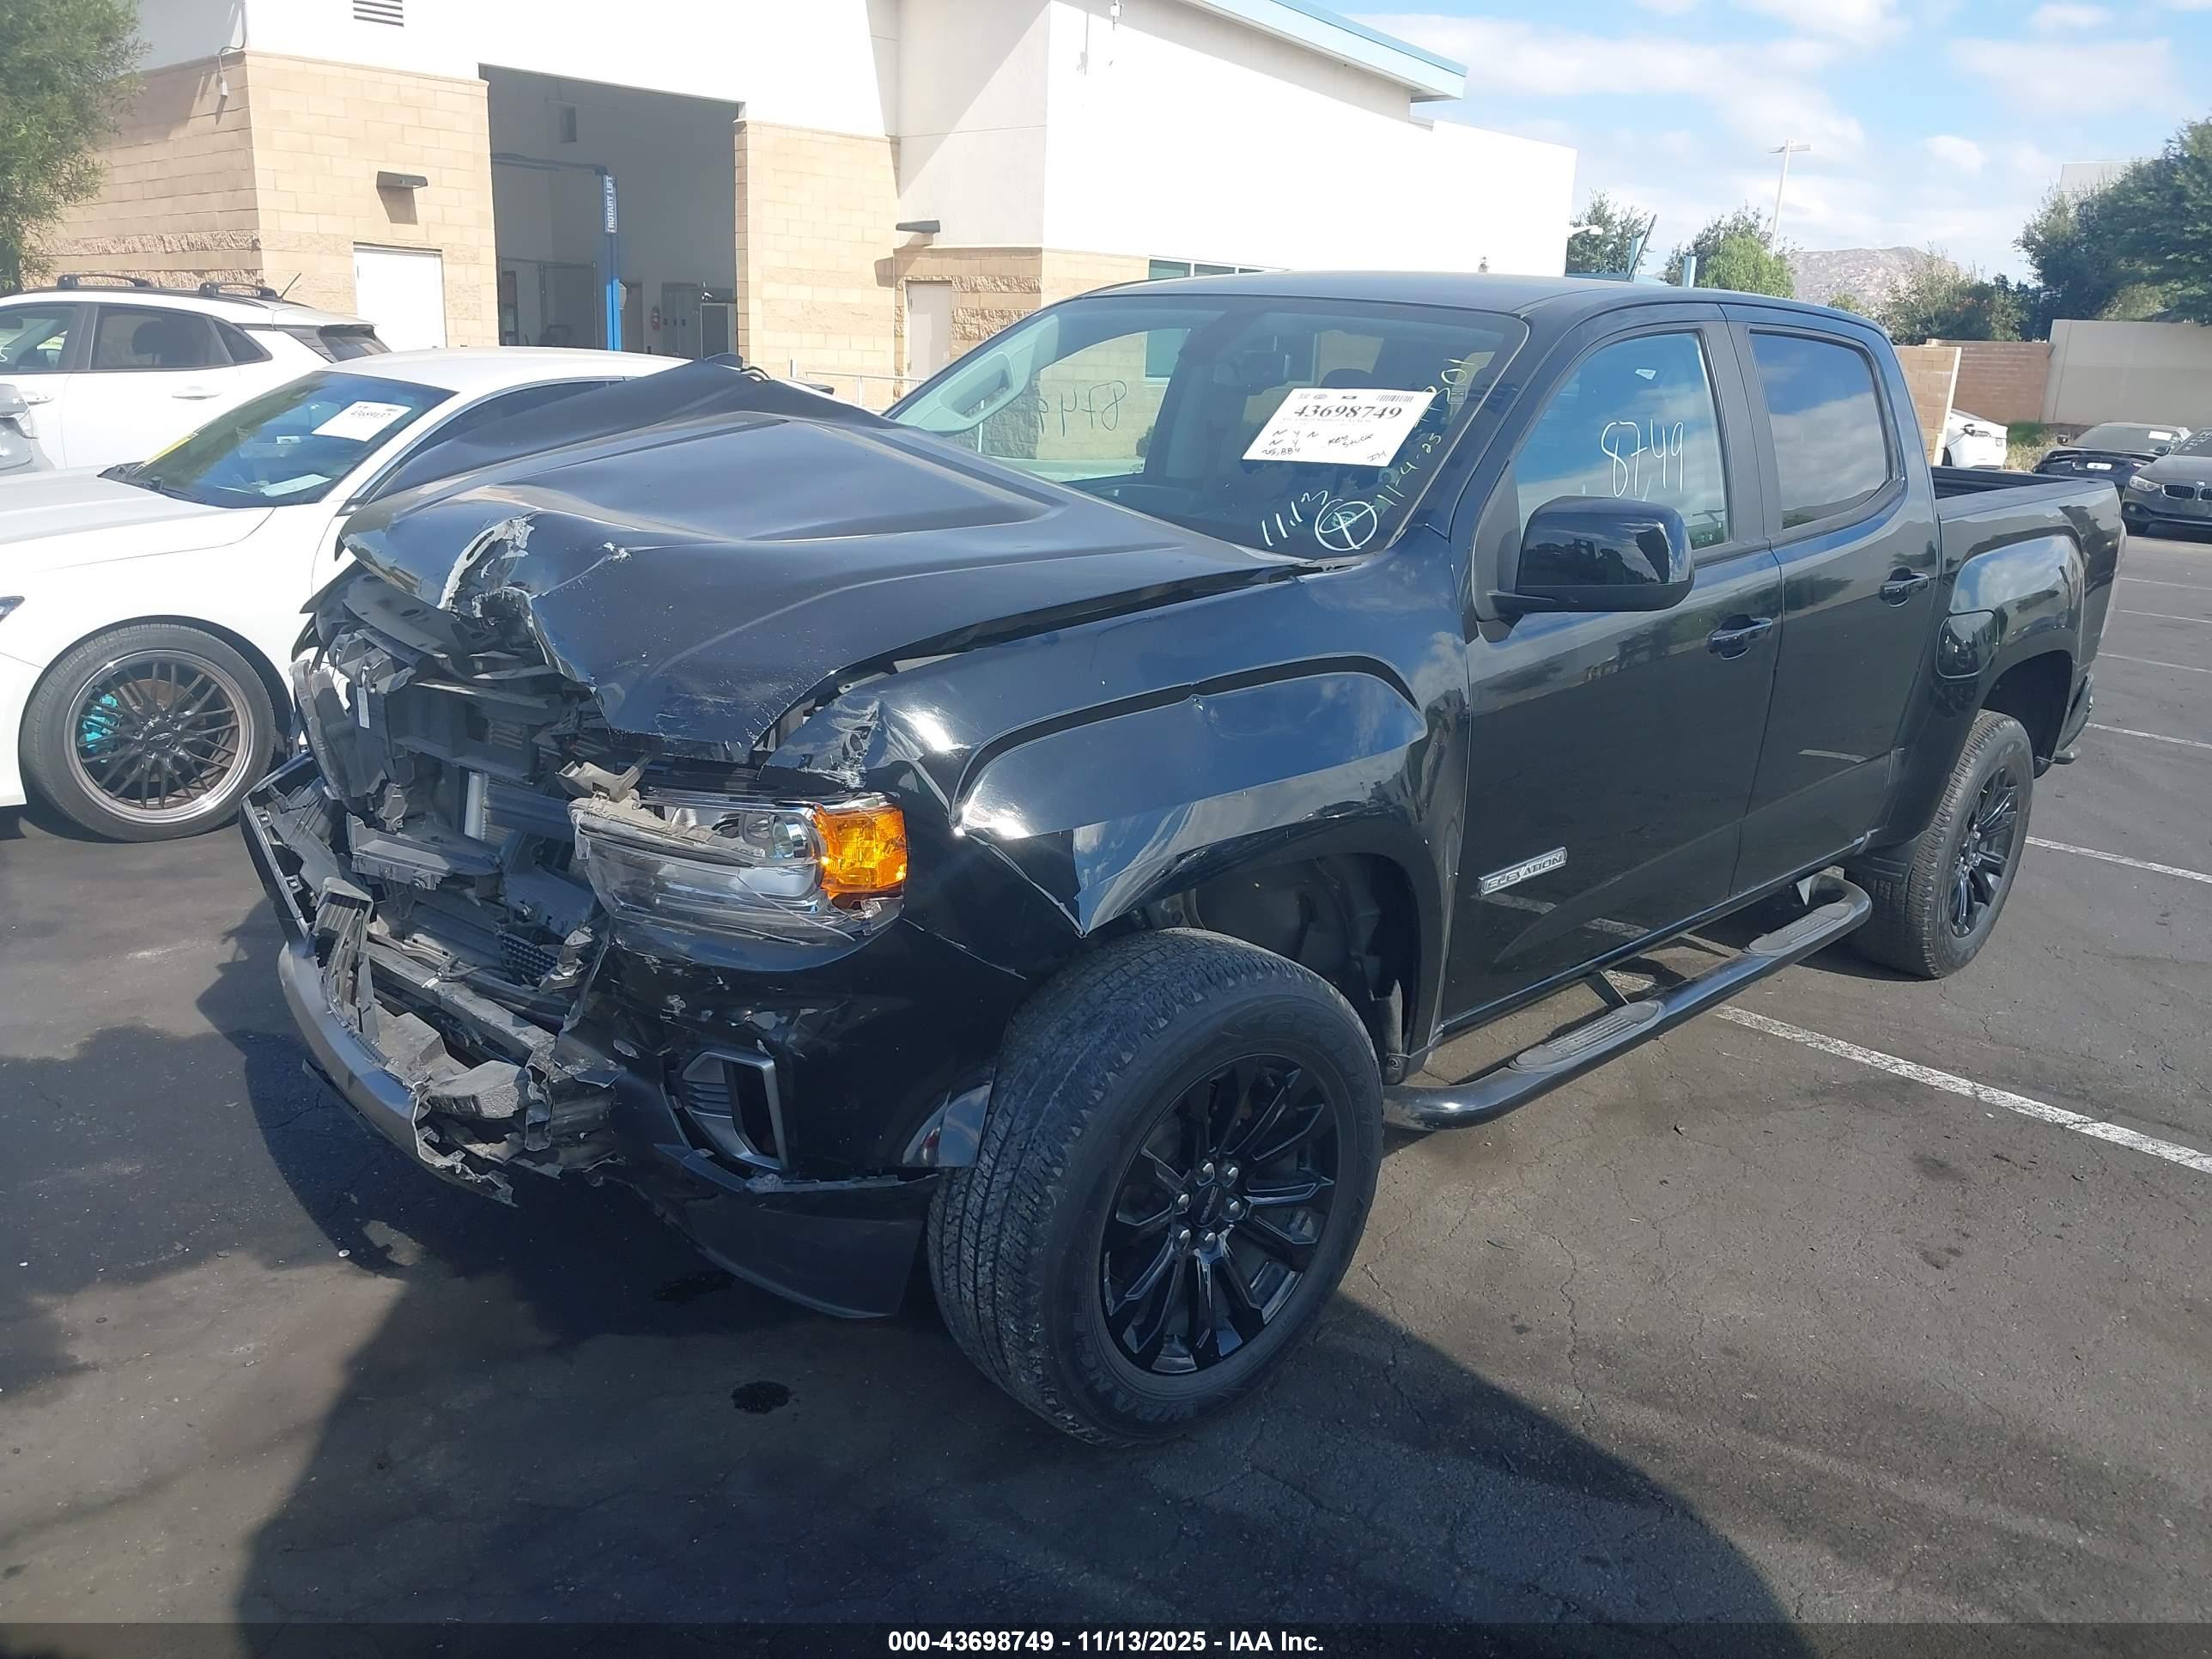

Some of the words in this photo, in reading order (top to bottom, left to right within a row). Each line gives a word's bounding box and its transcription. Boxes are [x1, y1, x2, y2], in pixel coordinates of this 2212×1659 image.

[606, 195, 615, 228] ROTARY
[1294, 404, 1402, 419] 43698749
[1601, 418, 1684, 497] 8749
[1486, 853, 1563, 890] ELEVATION
